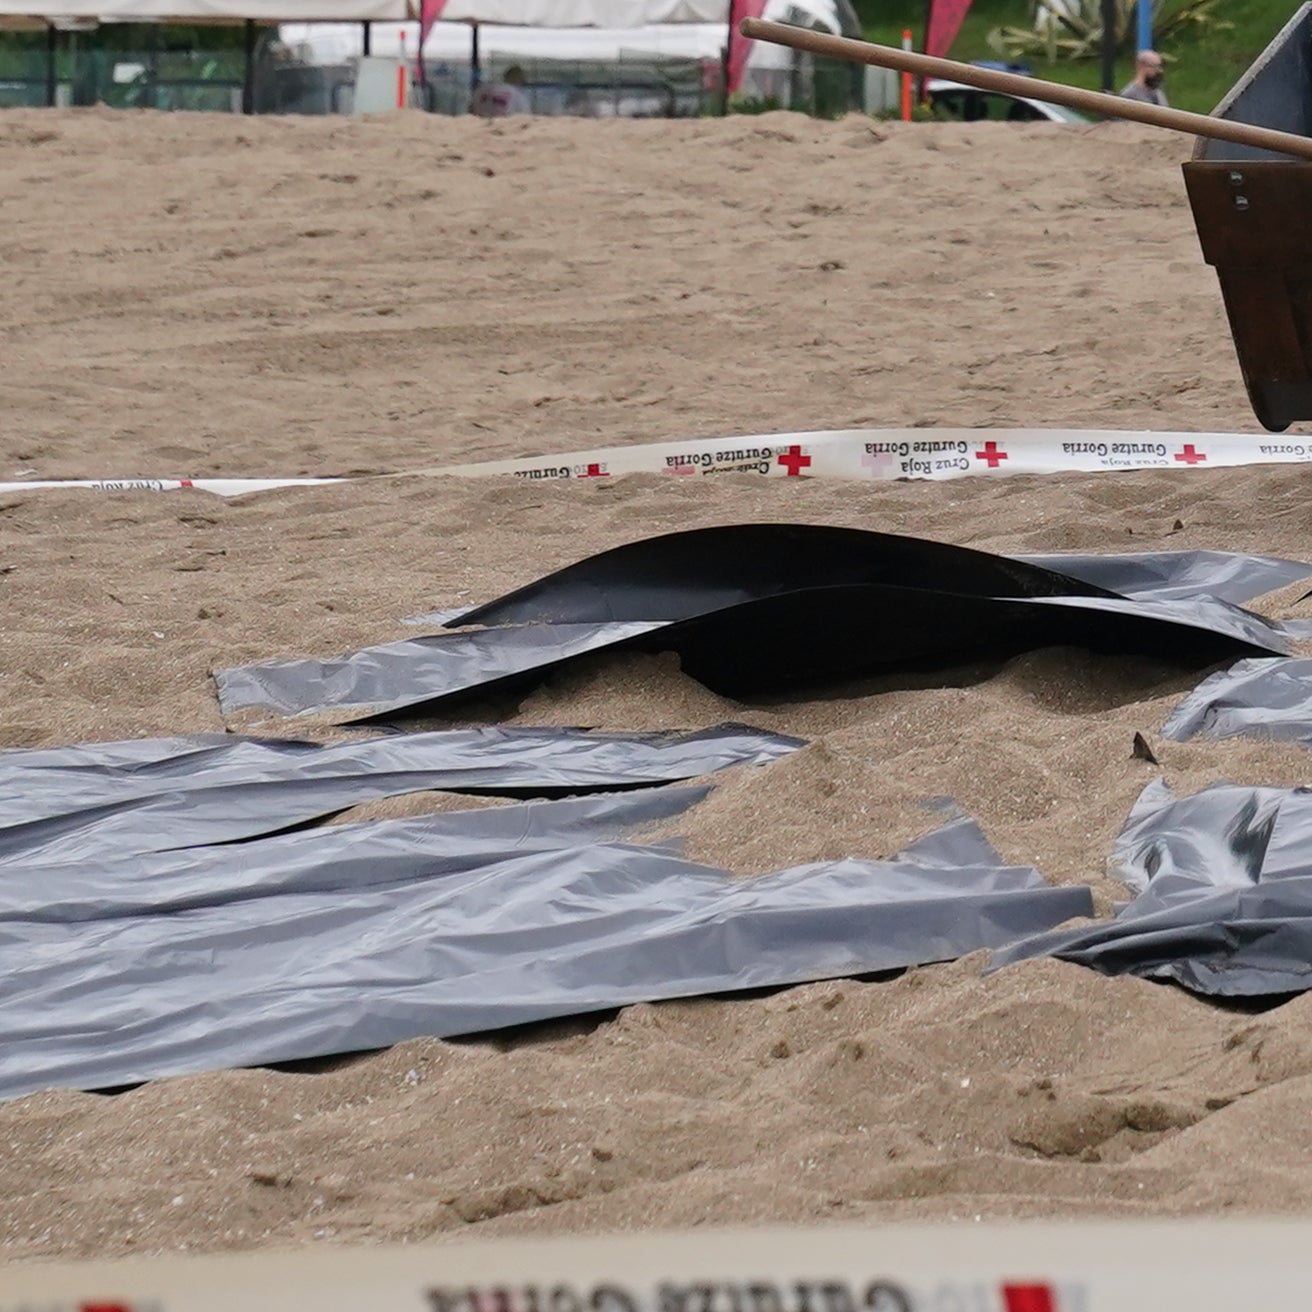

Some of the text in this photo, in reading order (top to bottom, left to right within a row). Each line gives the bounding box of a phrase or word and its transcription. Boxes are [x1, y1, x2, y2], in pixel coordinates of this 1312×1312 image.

[865, 441, 968, 457] Gurutze Gorria
[1063, 443, 1166, 456] Gurutze Gorria
[1259, 445, 1305, 456] Gorria
[666, 447, 772, 469] Gurutze Gorria
[901, 458, 969, 475] Cruz Roja
